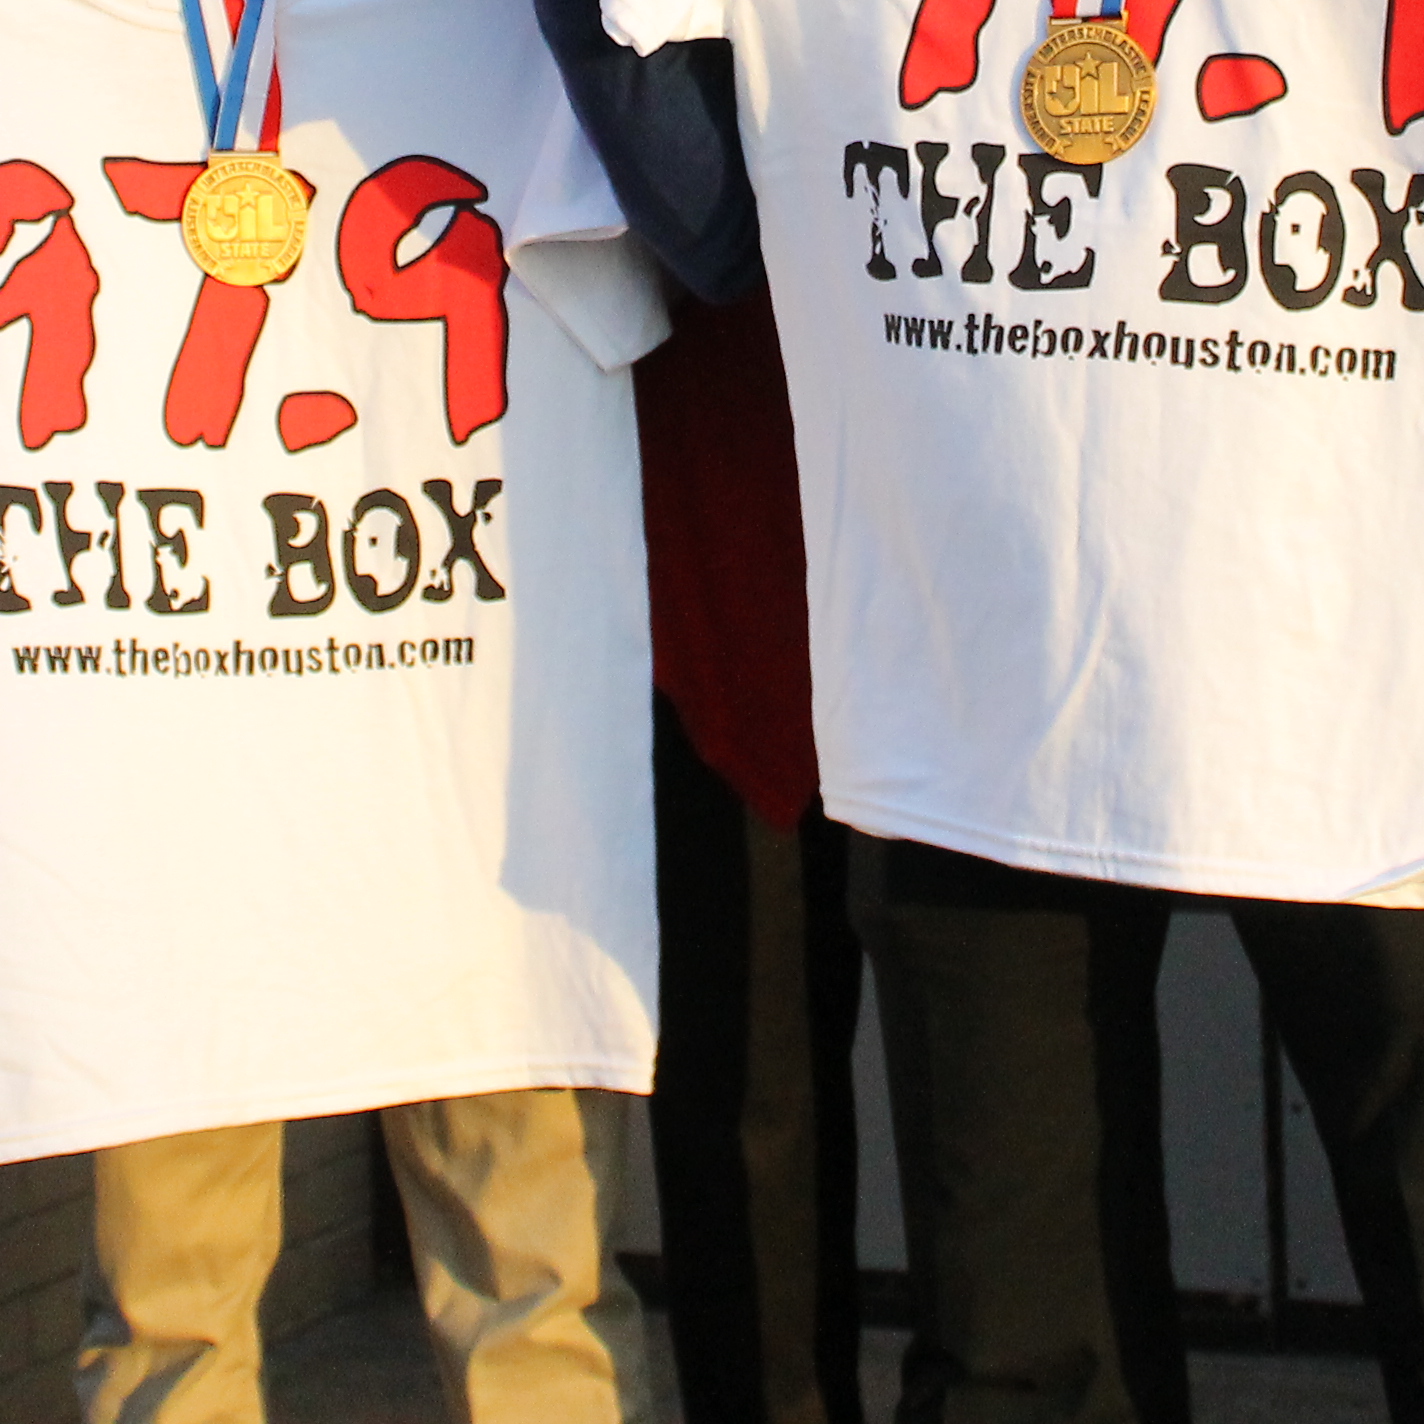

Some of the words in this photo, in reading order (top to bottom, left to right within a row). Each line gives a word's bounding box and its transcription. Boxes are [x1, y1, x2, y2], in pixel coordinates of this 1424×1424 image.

[1059, 116, 1115, 135] STATE
[843, 140, 1103, 291] THE
[219, 242, 271, 259] STATE
[883, 312, 1397, 381] www.theboxhouston.com
[263, 479, 506, 618] BOX
[11, 635, 475, 679] www.theboxhouston.com
